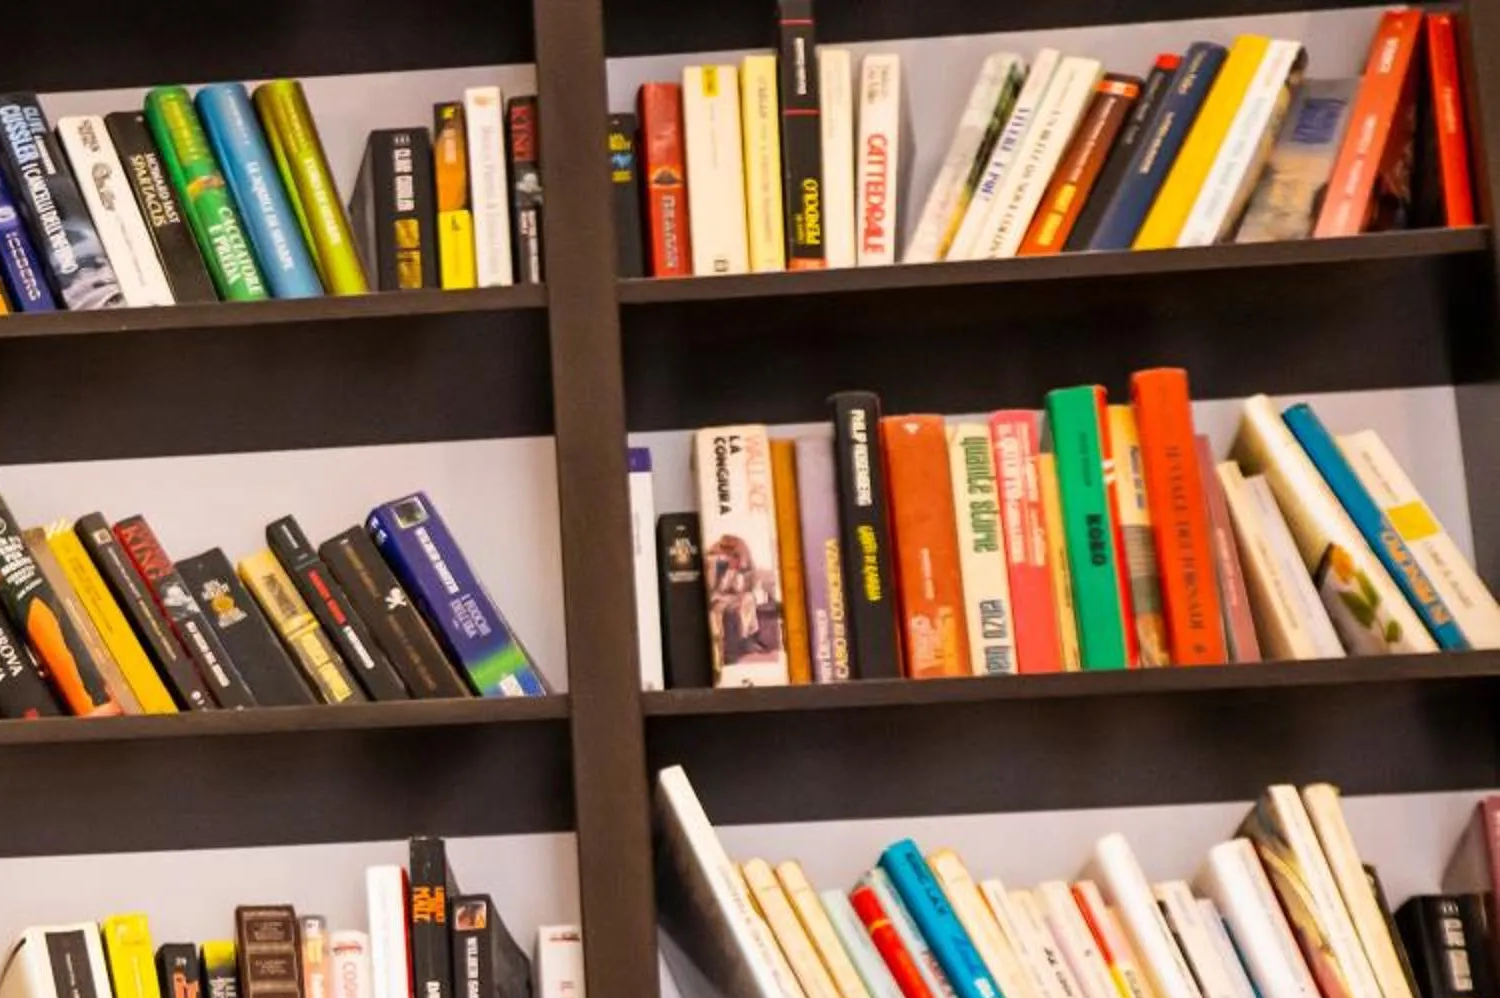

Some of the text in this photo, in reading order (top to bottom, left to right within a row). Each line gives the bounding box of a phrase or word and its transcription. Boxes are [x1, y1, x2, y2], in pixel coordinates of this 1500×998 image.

[713, 436, 733, 515] CONGIURA
[728, 436, 742, 454] LA
[959, 435, 1001, 553] quante storie
